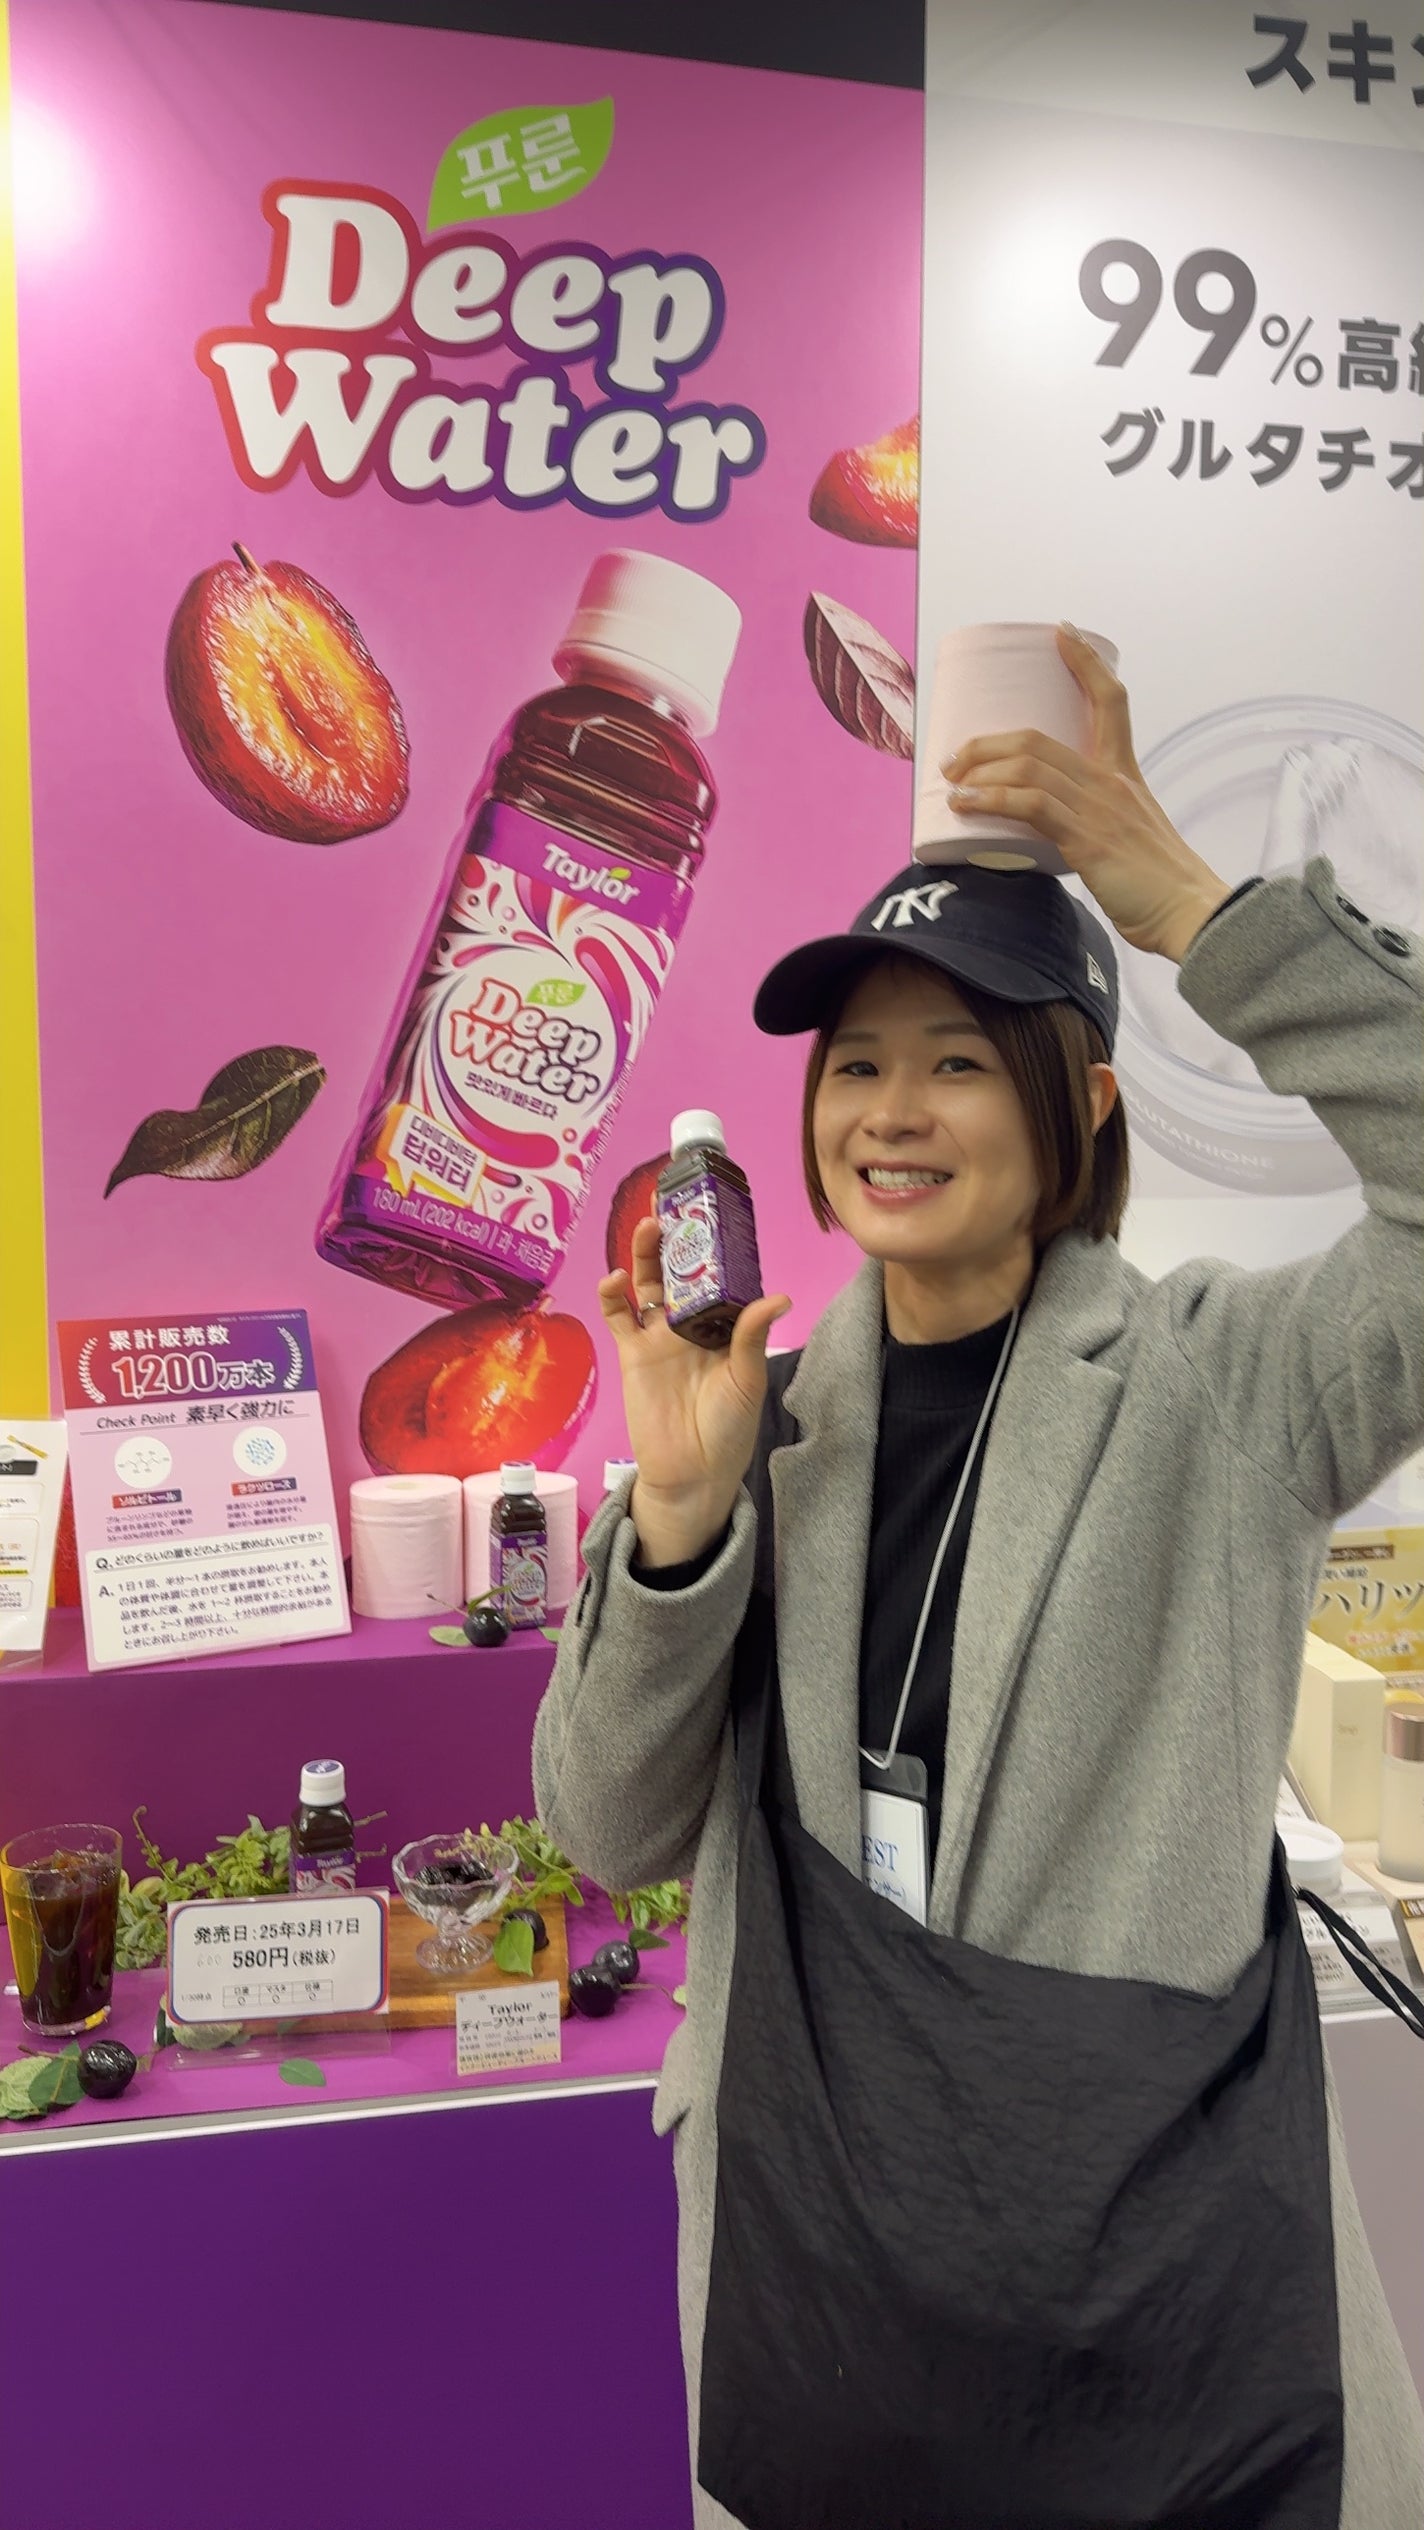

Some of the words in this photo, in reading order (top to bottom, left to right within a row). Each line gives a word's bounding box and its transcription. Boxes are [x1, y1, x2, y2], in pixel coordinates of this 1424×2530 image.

[1246, 15, 1424, 106] スキ
[457, 113, 588, 211] 푸룬
[262, 190, 716, 394] Deep
[208, 341, 756, 511] Water
[542, 842, 640, 905] Taylor
[870, 879, 960, 932] NY
[470, 978, 601, 1066] Deep
[450, 1011, 601, 1102] Water
[401, 1131, 472, 1193] 딥워터
[373, 1186, 401, 1214] 180
[109, 1324, 230, 1353] 累計販売数
[111, 1350, 276, 1400] 1,200万本
[96, 1413, 136, 1430] Check
[140, 1411, 177, 1426] Point
[186, 1399, 296, 1425] 素早く強力に
[488, 2001, 533, 2016] Taylor
